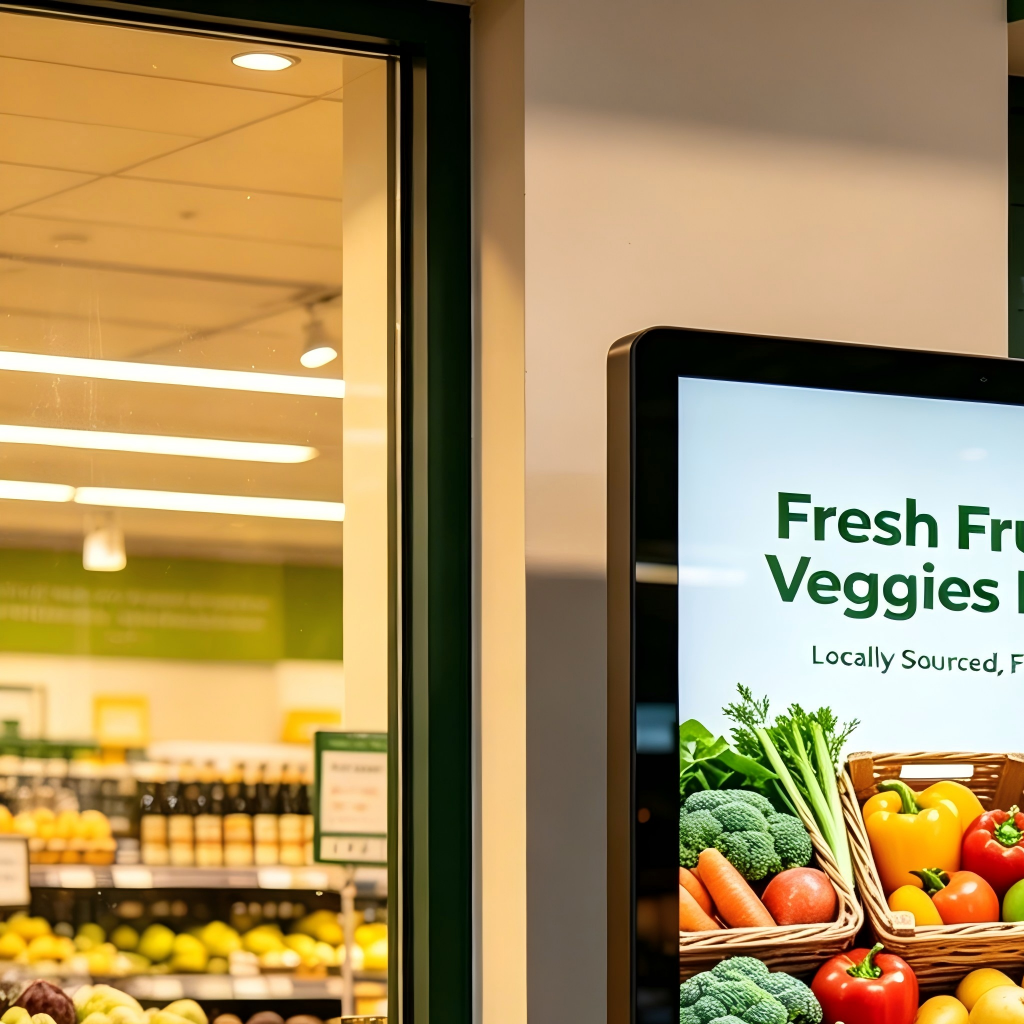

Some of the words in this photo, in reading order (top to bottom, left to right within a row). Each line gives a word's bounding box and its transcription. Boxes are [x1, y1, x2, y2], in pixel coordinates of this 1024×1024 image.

[777, 491, 939, 549] Fresh
[764, 553, 1000, 621] Veggies
[812, 645, 896, 675] Locally
[901, 649, 1004, 677] Sourced,
